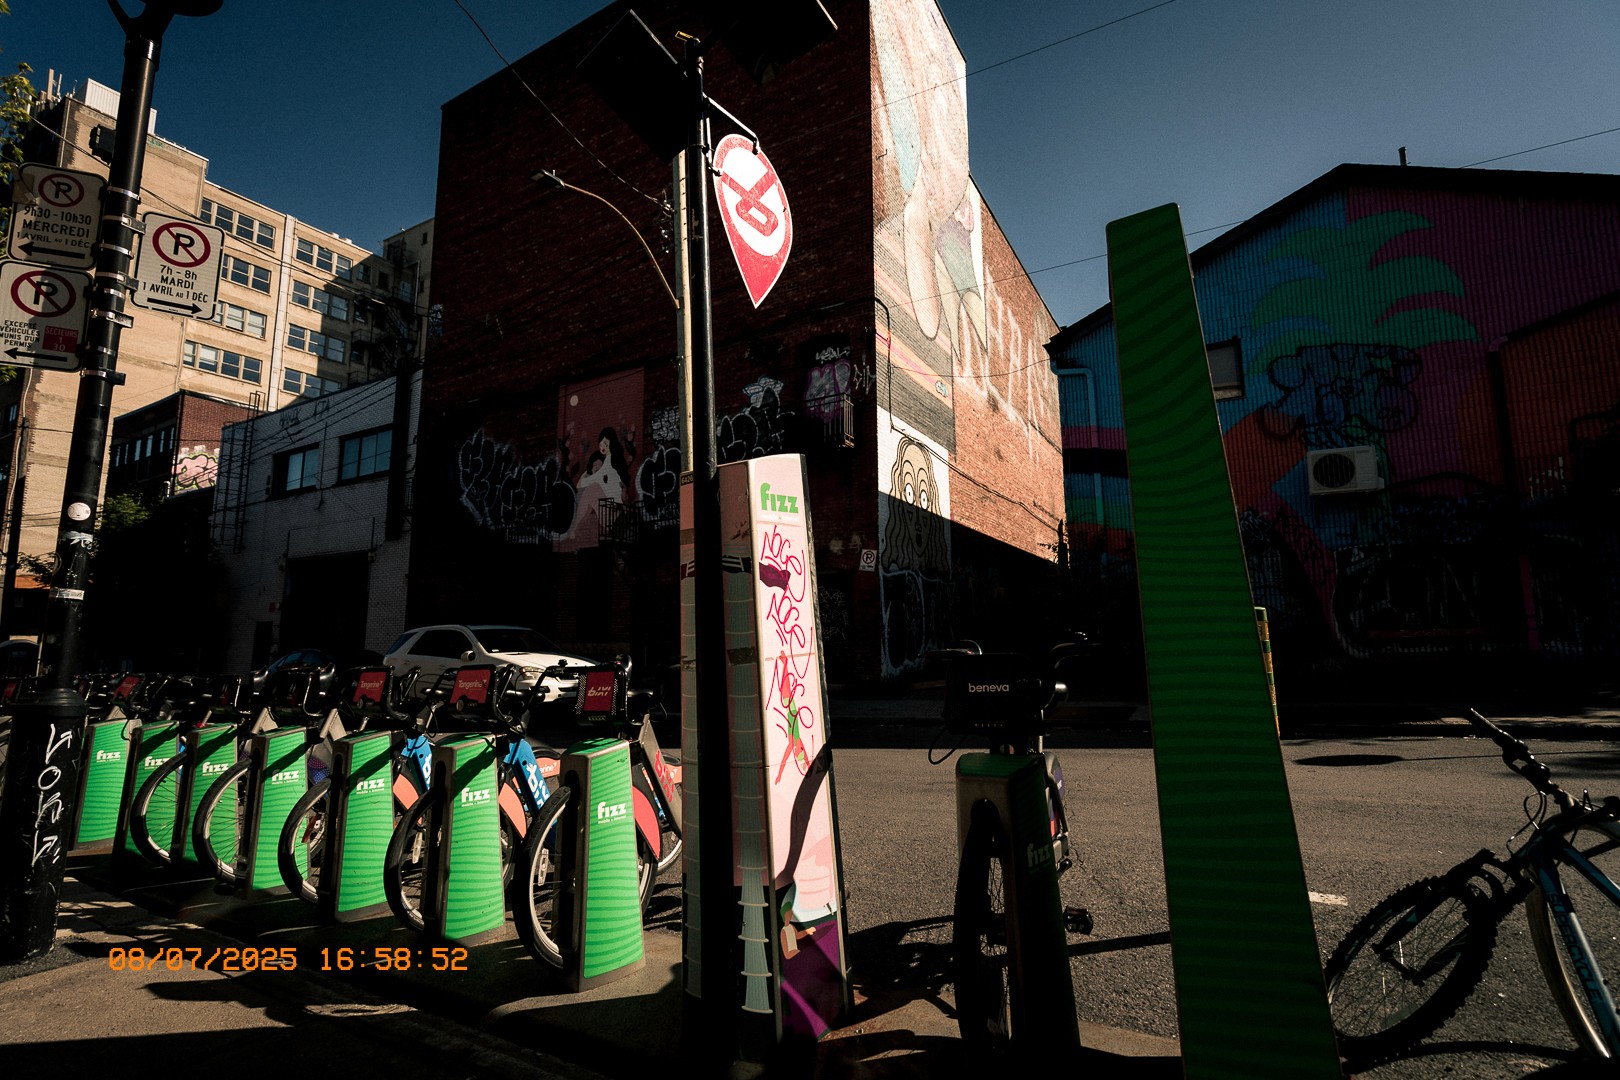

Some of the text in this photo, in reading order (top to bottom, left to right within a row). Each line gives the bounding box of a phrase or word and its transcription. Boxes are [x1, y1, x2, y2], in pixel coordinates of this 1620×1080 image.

[24, 205, 51, 219] 9h30
[61, 211, 92, 225] 10h30
[22, 219, 90, 239] MERCREDI
[22, 232, 52, 243] AVRIL
[160, 264, 173, 276] 7h
[184, 270, 198, 281] 8h
[160, 275, 194, 290] MARDI
[149, 283, 174, 297] AVRIL
[192, 292, 208, 304] DÉC
[0, 325, 41, 337] VÉHICULES
[4, 320, 38, 330] EXCEPTÉ
[45, 327, 79, 337] SECTEURS
[4, 339, 32, 348] PERMIS
[52, 344, 66, 352] 30
[760, 483, 799, 514] fizz
[968, 683, 1010, 693] beneva
[96, 750, 121, 760] fizz
[202, 762, 229, 774] fizz
[271, 769, 299, 781] fizz
[357, 776, 385, 790] fizz
[461, 787, 490, 803] fizz
[598, 801, 626, 819] fizz
[1027, 842, 1051, 868] fizz
[1549, 889, 1600, 999] SUPERCYCLE
